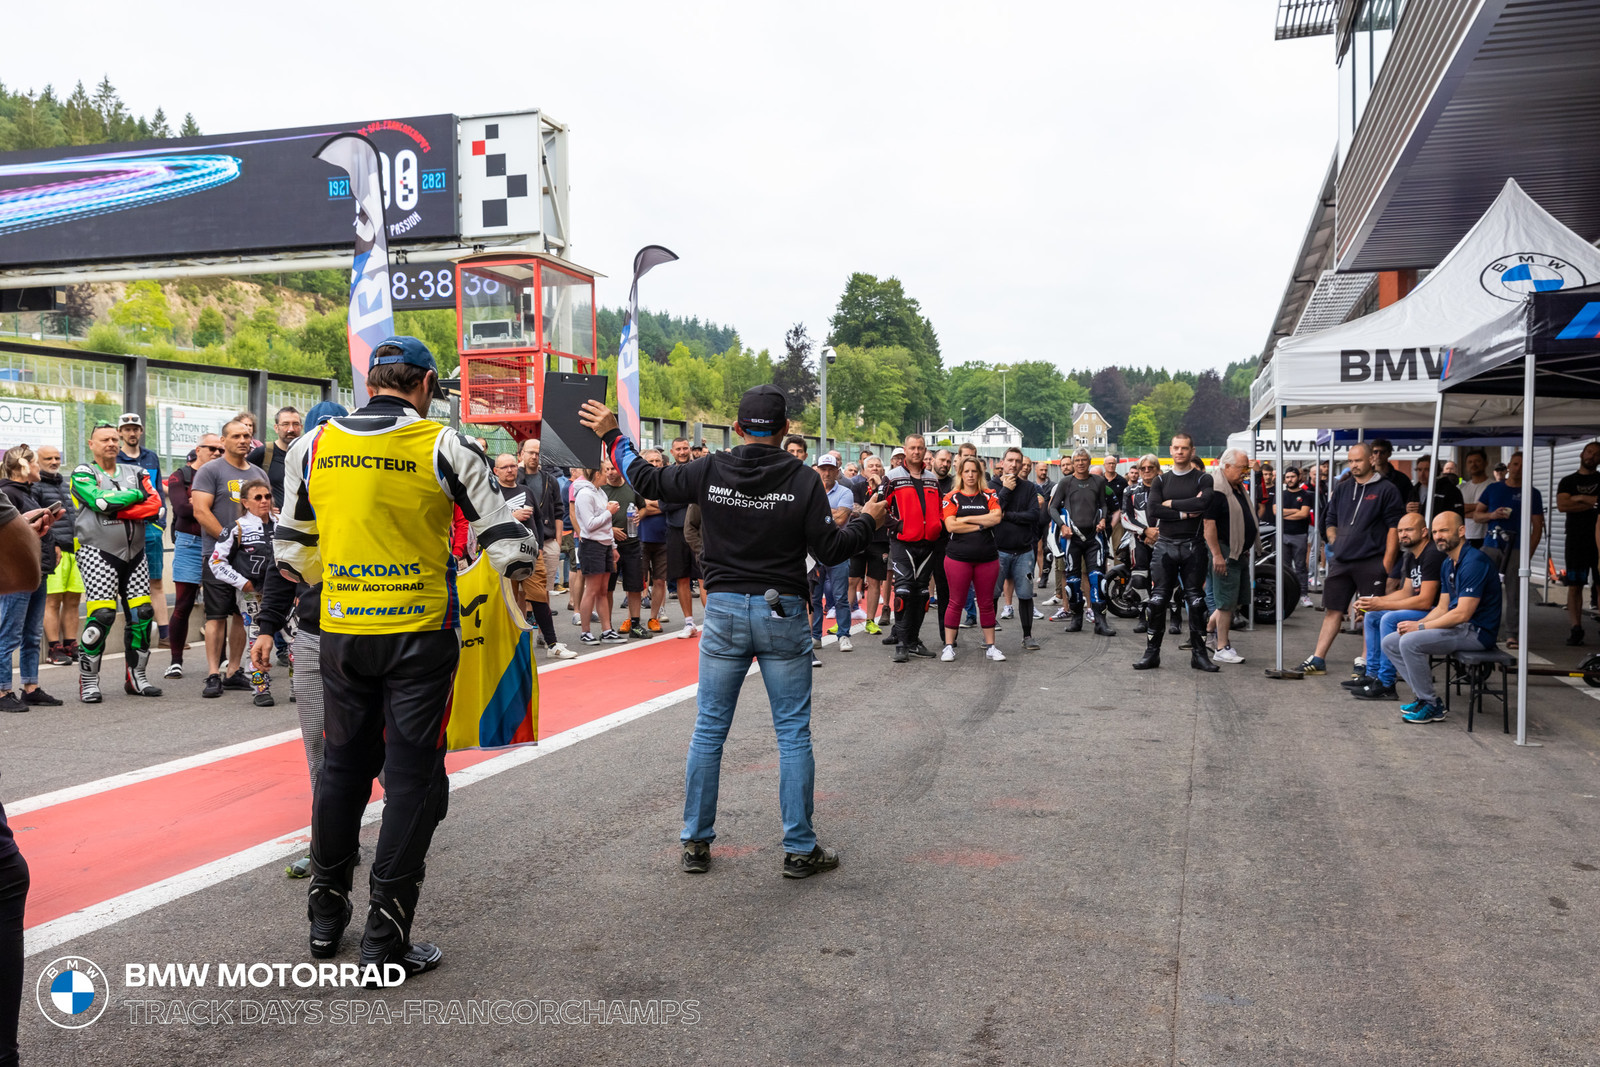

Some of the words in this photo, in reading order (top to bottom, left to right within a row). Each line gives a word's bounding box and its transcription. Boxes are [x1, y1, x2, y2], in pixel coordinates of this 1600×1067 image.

[328, 180, 350, 197] 1921
[421, 172, 446, 190] 2021
[389, 210, 422, 237] PASSION
[1491, 255, 1566, 273] BMW
[316, 455, 417, 473] INSTRUCTEUR
[708, 485, 733, 497] BMW
[707, 493, 777, 510] MOTORSPORT
[250, 554, 266, 575] 7
[328, 563, 421, 578] TRACKDAYS
[336, 583, 360, 592] BMW
[362, 582, 424, 592] MOTORRAD
[346, 604, 425, 616] MICHELIN
